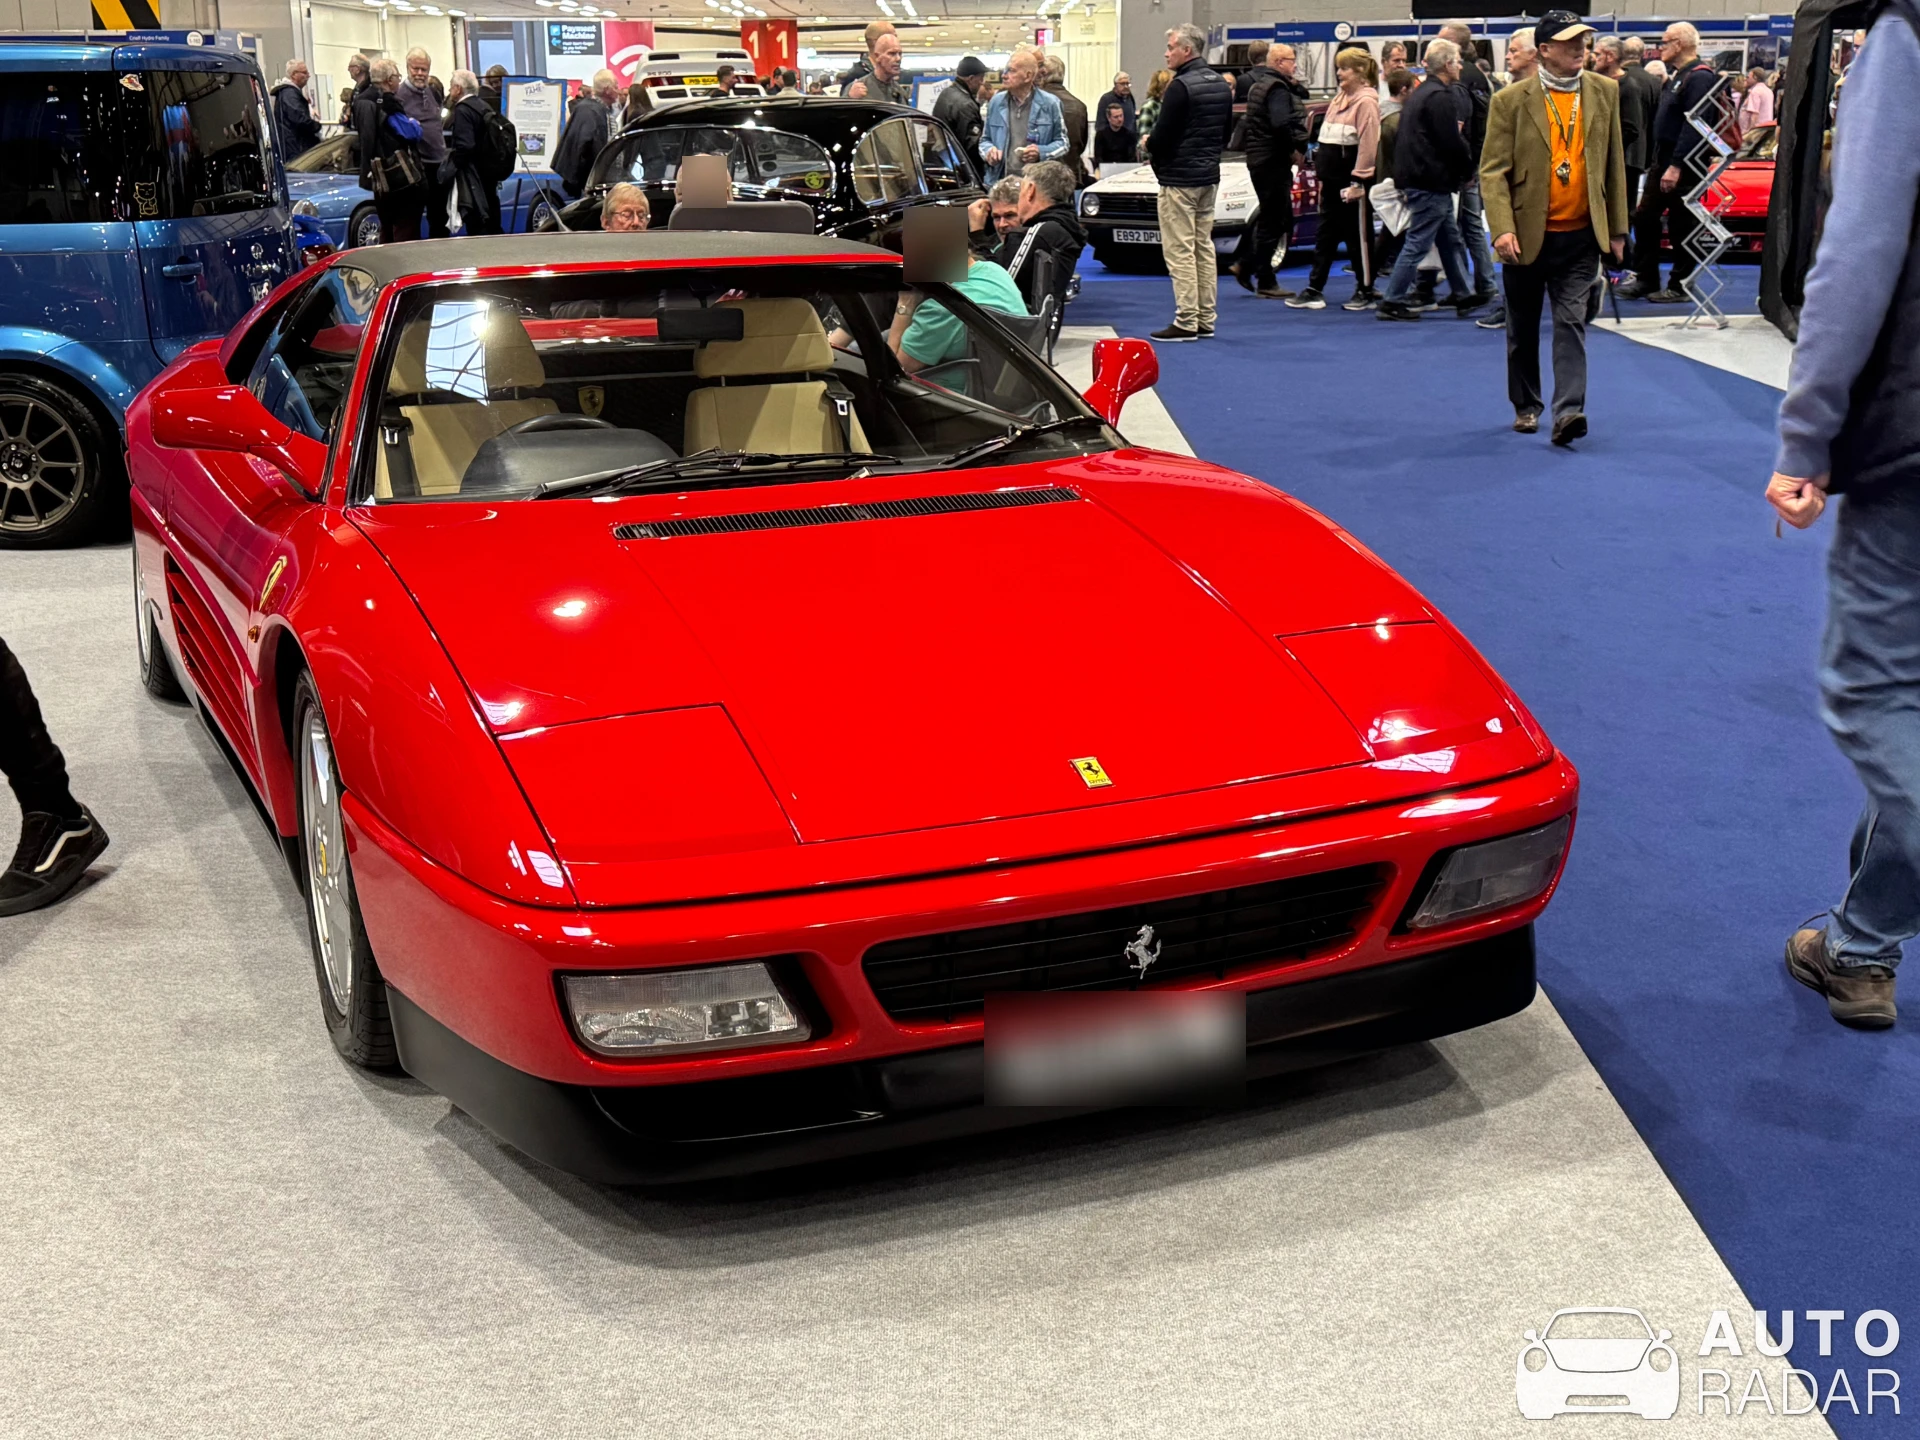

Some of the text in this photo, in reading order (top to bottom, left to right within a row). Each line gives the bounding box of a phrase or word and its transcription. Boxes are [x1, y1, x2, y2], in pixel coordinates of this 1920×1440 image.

[562, 25, 597, 33] Payment
[749, 30, 759, 59] 1
[776, 30, 788, 59] 1
[1116, 230, 1162, 243] E892 DPU
